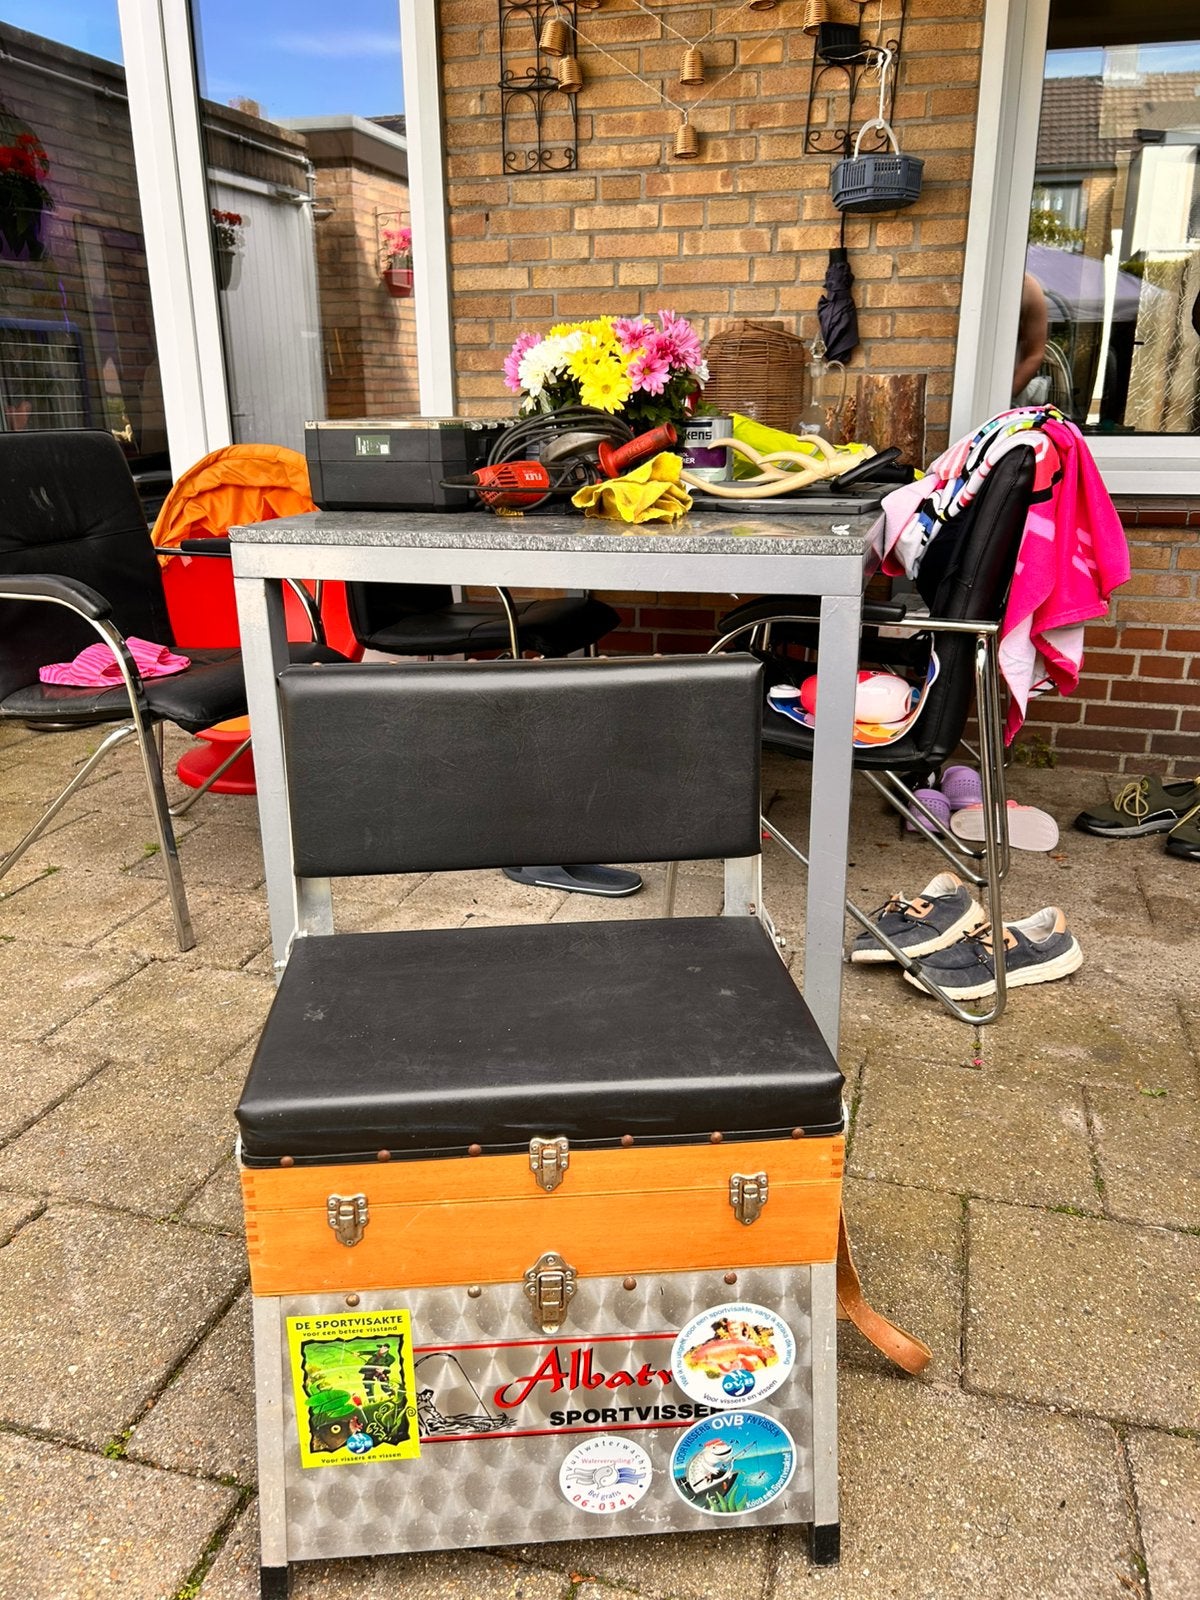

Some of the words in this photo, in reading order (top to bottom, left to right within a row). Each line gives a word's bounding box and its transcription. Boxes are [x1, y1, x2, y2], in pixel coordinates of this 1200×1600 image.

[686, 431, 712, 440] kens
[296, 1322, 311, 1330] DE
[315, 1315, 403, 1330] SPORTVISAKTE
[338, 1327, 363, 1335] betere
[366, 1325, 398, 1333] visstand
[685, 1325, 697, 1338] voor
[696, 1316, 709, 1326] een
[755, 1310, 771, 1320] vang
[493, 1346, 673, 1409] Albatr
[704, 1392, 718, 1402] Voor
[757, 1380, 778, 1395] vissen
[550, 1404, 724, 1426] SPORTVISSE
[684, 1423, 711, 1450] VISSERS
[711, 1414, 744, 1430] OVB
[573, 1493, 635, 1510] 06-0341
[588, 1489, 600, 1499] Bel
[601, 1490, 622, 1501] gratis
